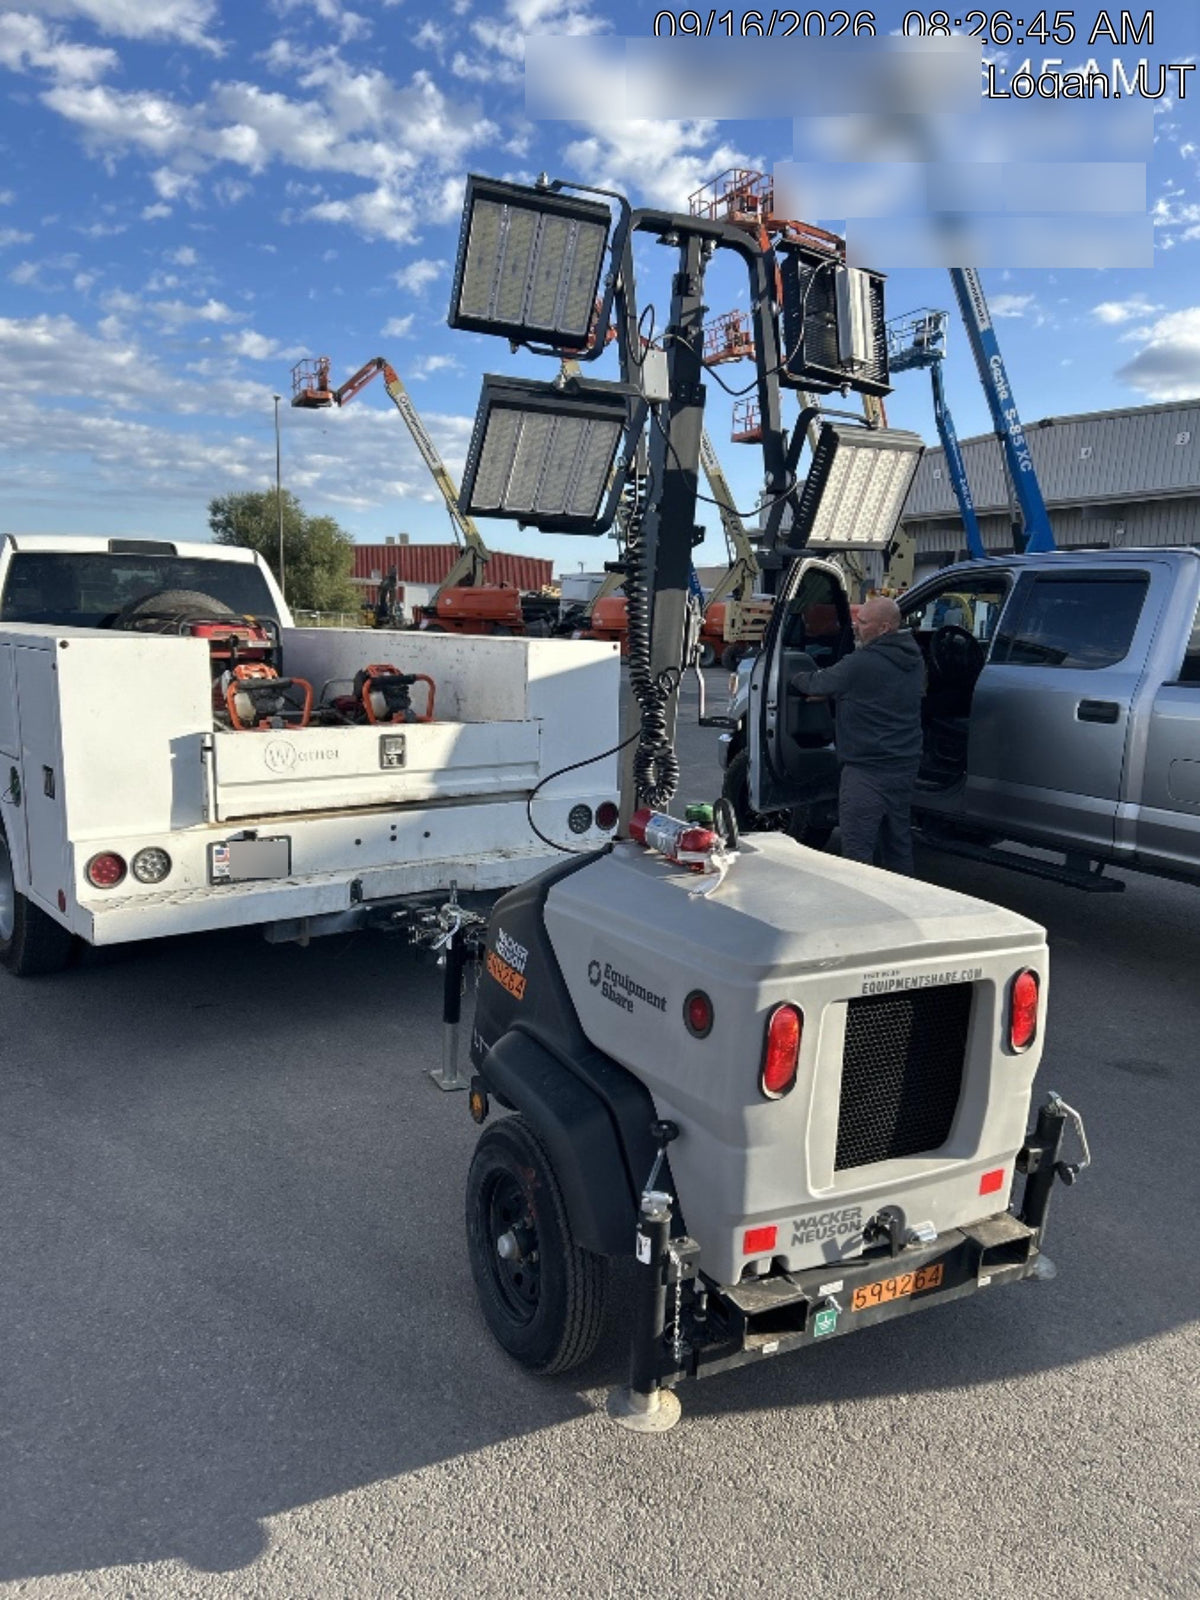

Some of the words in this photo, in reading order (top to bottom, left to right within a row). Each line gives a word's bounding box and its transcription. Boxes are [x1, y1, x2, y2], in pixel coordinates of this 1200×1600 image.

[604, 963, 668, 1012] Equipment
[862, 968, 983, 994] EQUIPMENTSHARE.COM
[601, 981, 634, 1013] Share
[790, 1219, 861, 1247] NEUSON
[792, 1206, 862, 1232] WACKER
[854, 1264, 940, 1309] 599264
